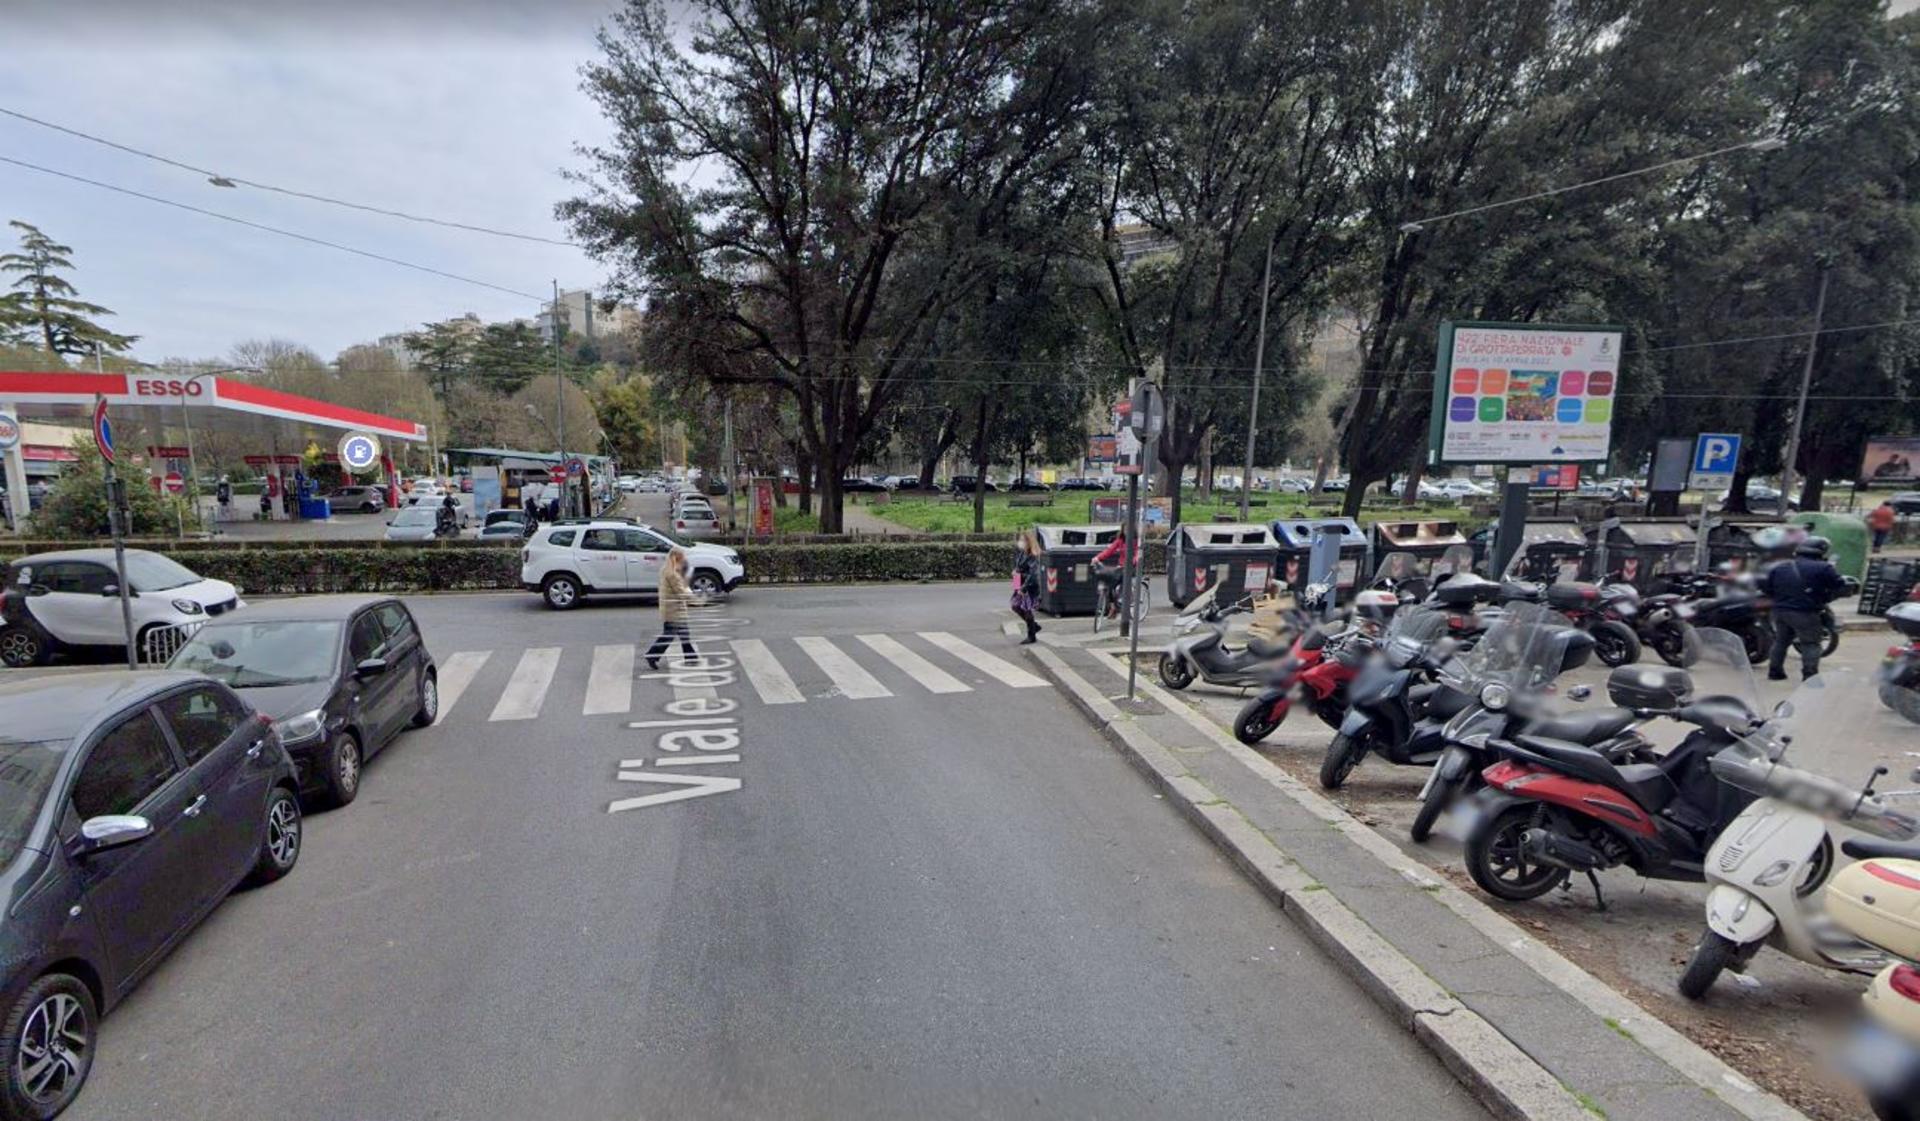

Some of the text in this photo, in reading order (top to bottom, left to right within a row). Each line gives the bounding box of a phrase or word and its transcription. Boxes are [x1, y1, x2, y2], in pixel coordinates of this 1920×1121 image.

[1521, 335, 1584, 346] NAZIONALE
[1471, 344, 1556, 355] GROTTAFERRATA
[136, 380, 202, 396] ESSO
[1702, 438, 1731, 469] P
